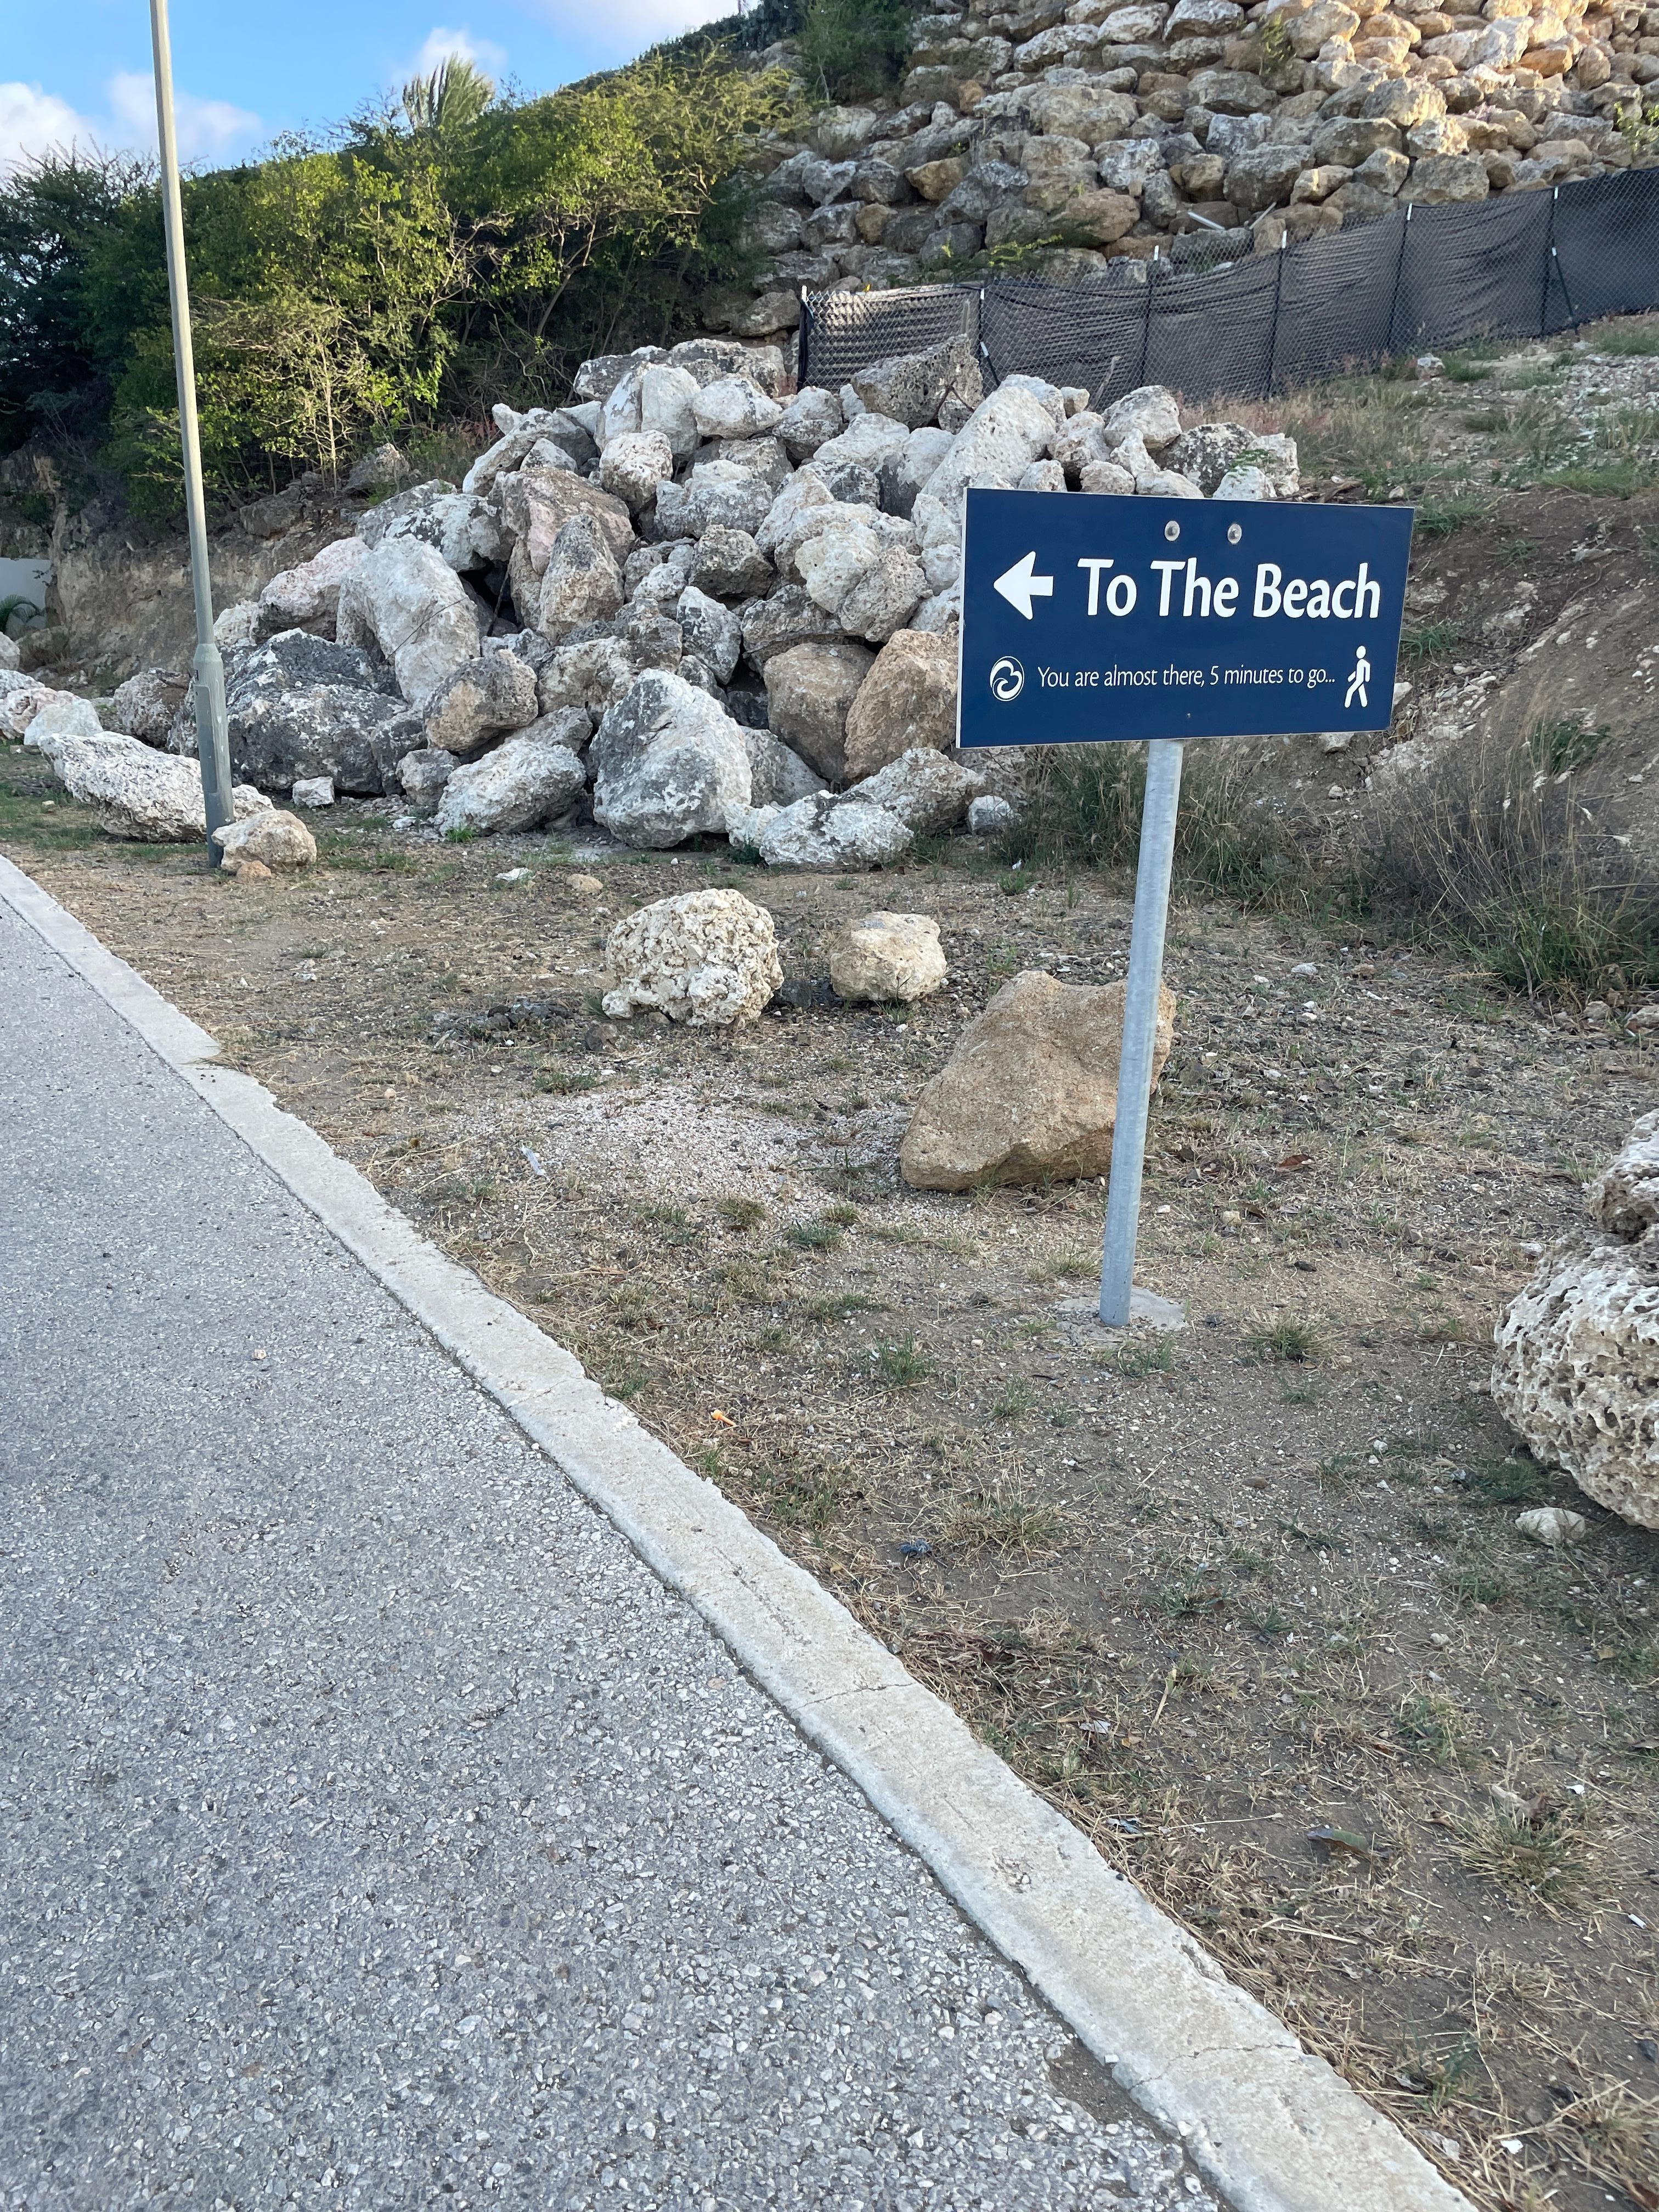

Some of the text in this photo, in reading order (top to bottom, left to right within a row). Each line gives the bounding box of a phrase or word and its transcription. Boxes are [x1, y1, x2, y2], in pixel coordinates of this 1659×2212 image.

[1077, 557, 1380, 619] To The Beach
[1037, 667, 1069, 687] You
[1074, 671, 1099, 687] are
[1104, 664, 1158, 686] almost
[1210, 665, 1219, 685] 5
[1224, 664, 1284, 685] minutes
[1288, 668, 1304, 684] to
[1307, 669, 1335, 689] go...
